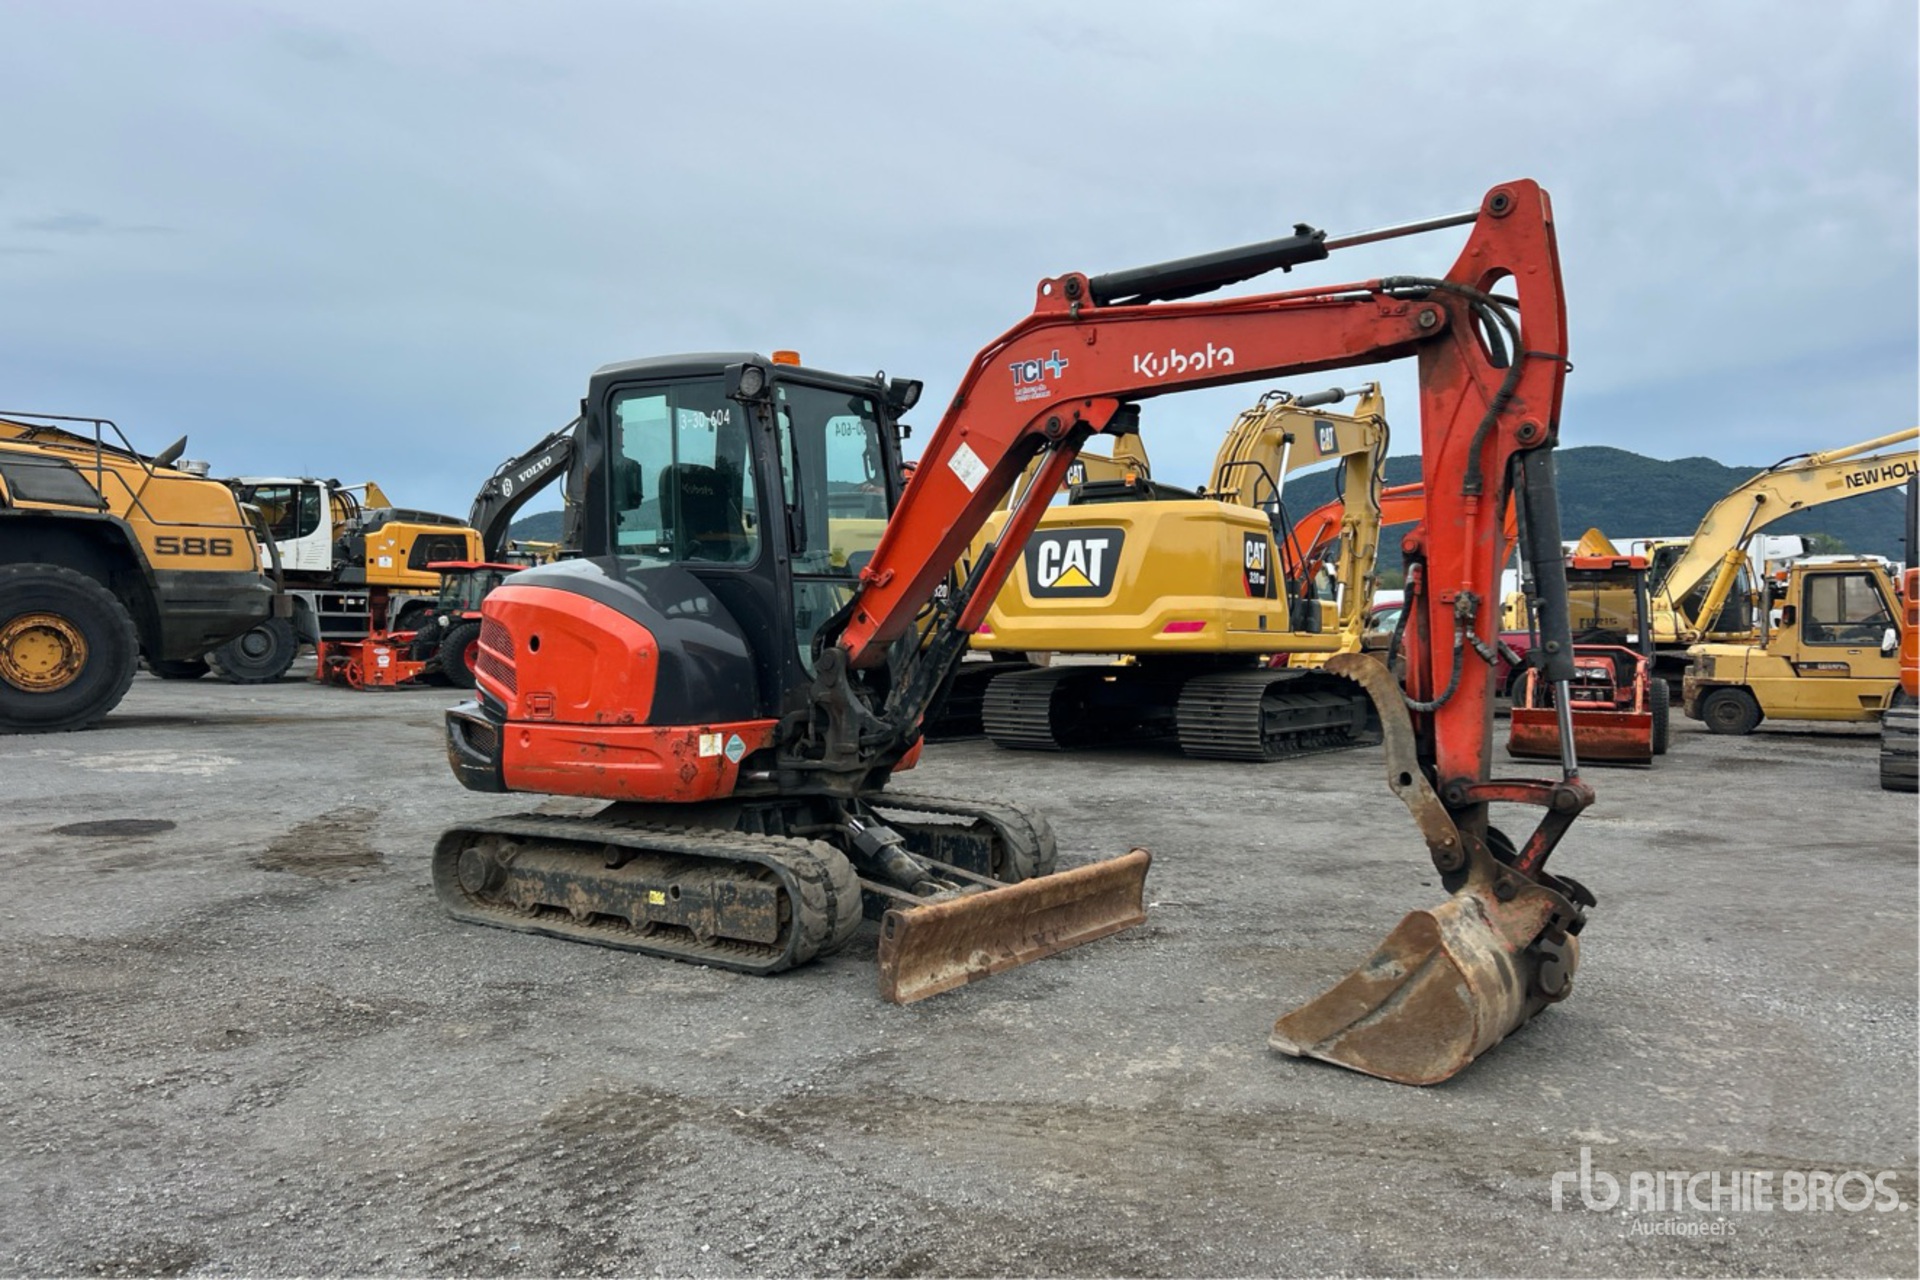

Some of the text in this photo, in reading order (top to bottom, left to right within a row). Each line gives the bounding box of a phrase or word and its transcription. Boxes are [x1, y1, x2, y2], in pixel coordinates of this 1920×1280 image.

[1133, 342, 1234, 378] Kubota
[1319, 427, 1334, 452] CAT
[518, 455, 552, 482] VOLVO
[1066, 464, 1083, 486] CAT
[1845, 468, 1879, 489] NEW
[154, 535, 233, 557] 586
[1246, 540, 1266, 570] CAT
[1037, 538, 1109, 588] CAT
